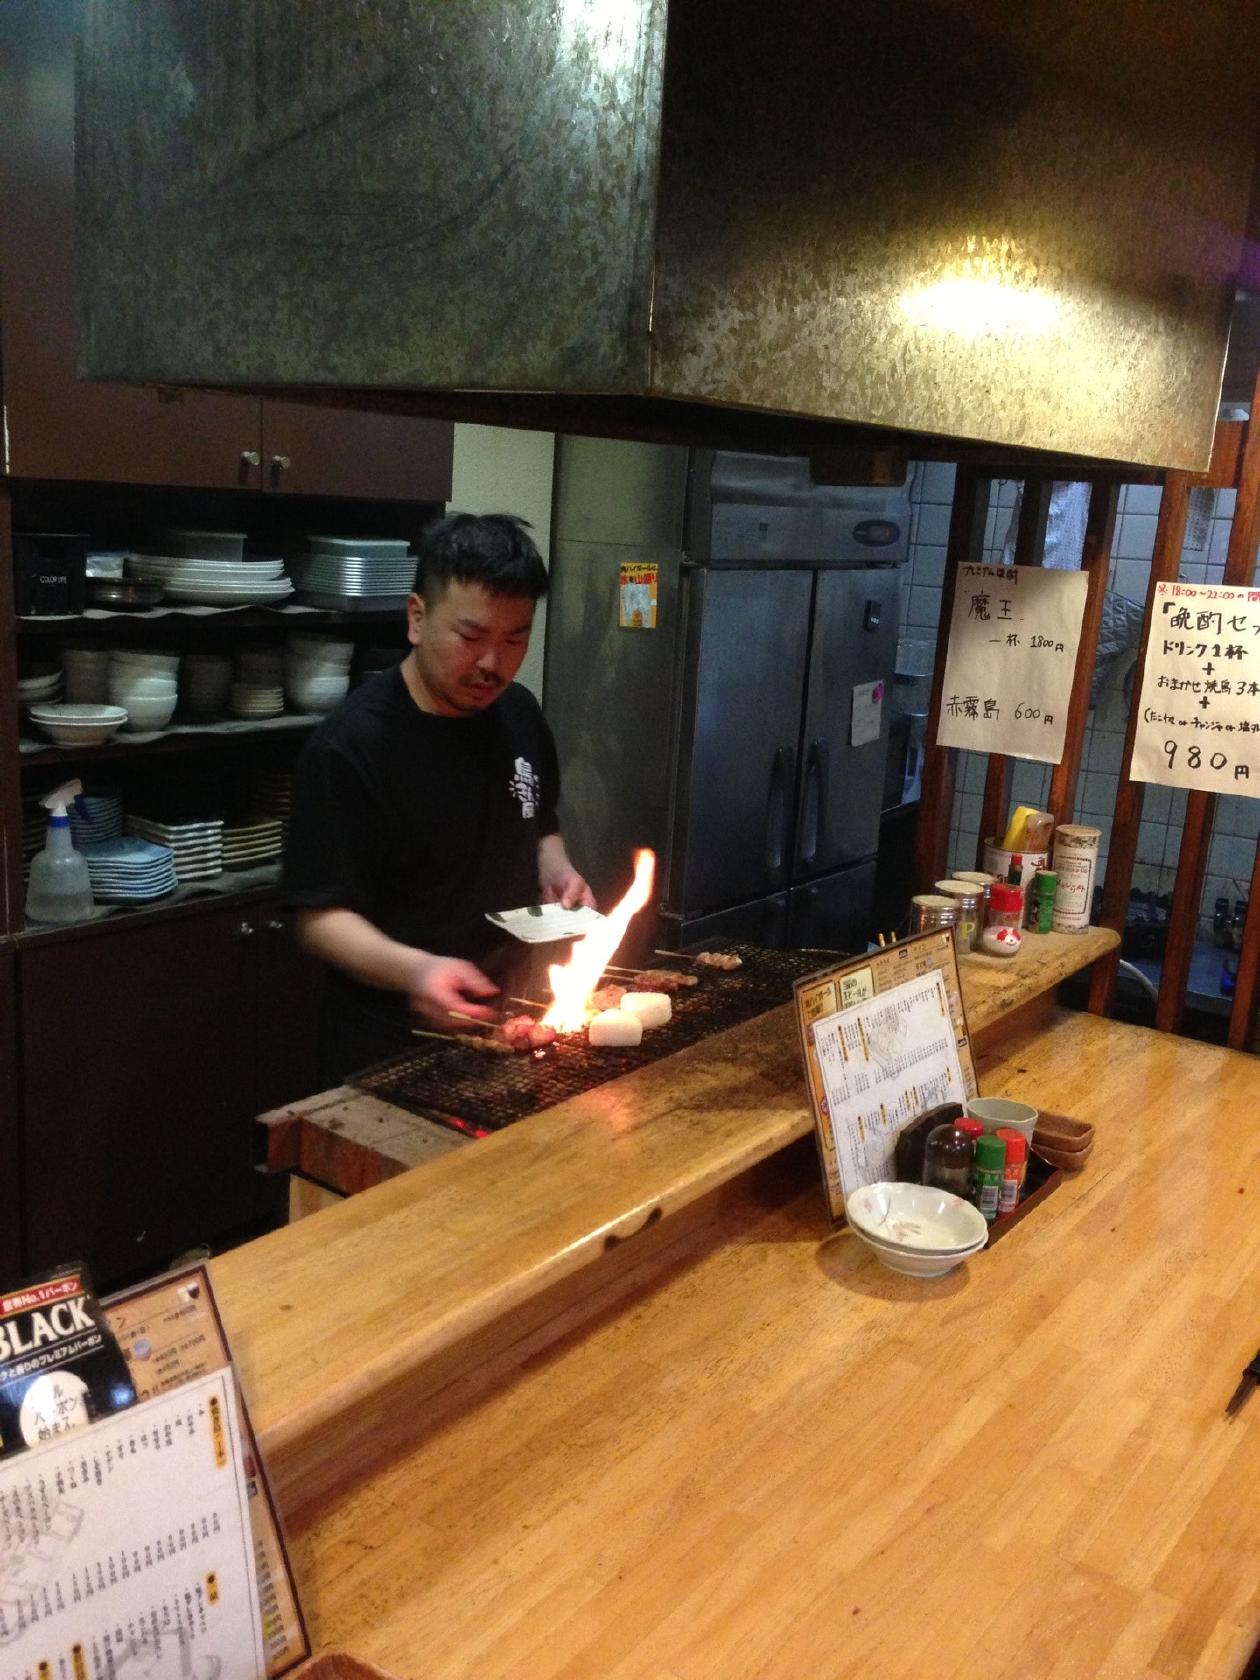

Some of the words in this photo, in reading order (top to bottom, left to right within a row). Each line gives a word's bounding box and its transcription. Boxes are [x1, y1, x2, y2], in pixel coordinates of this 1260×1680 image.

[946, 695, 1000, 720] 赤霧島
[1014, 702, 1054, 725] 600円
